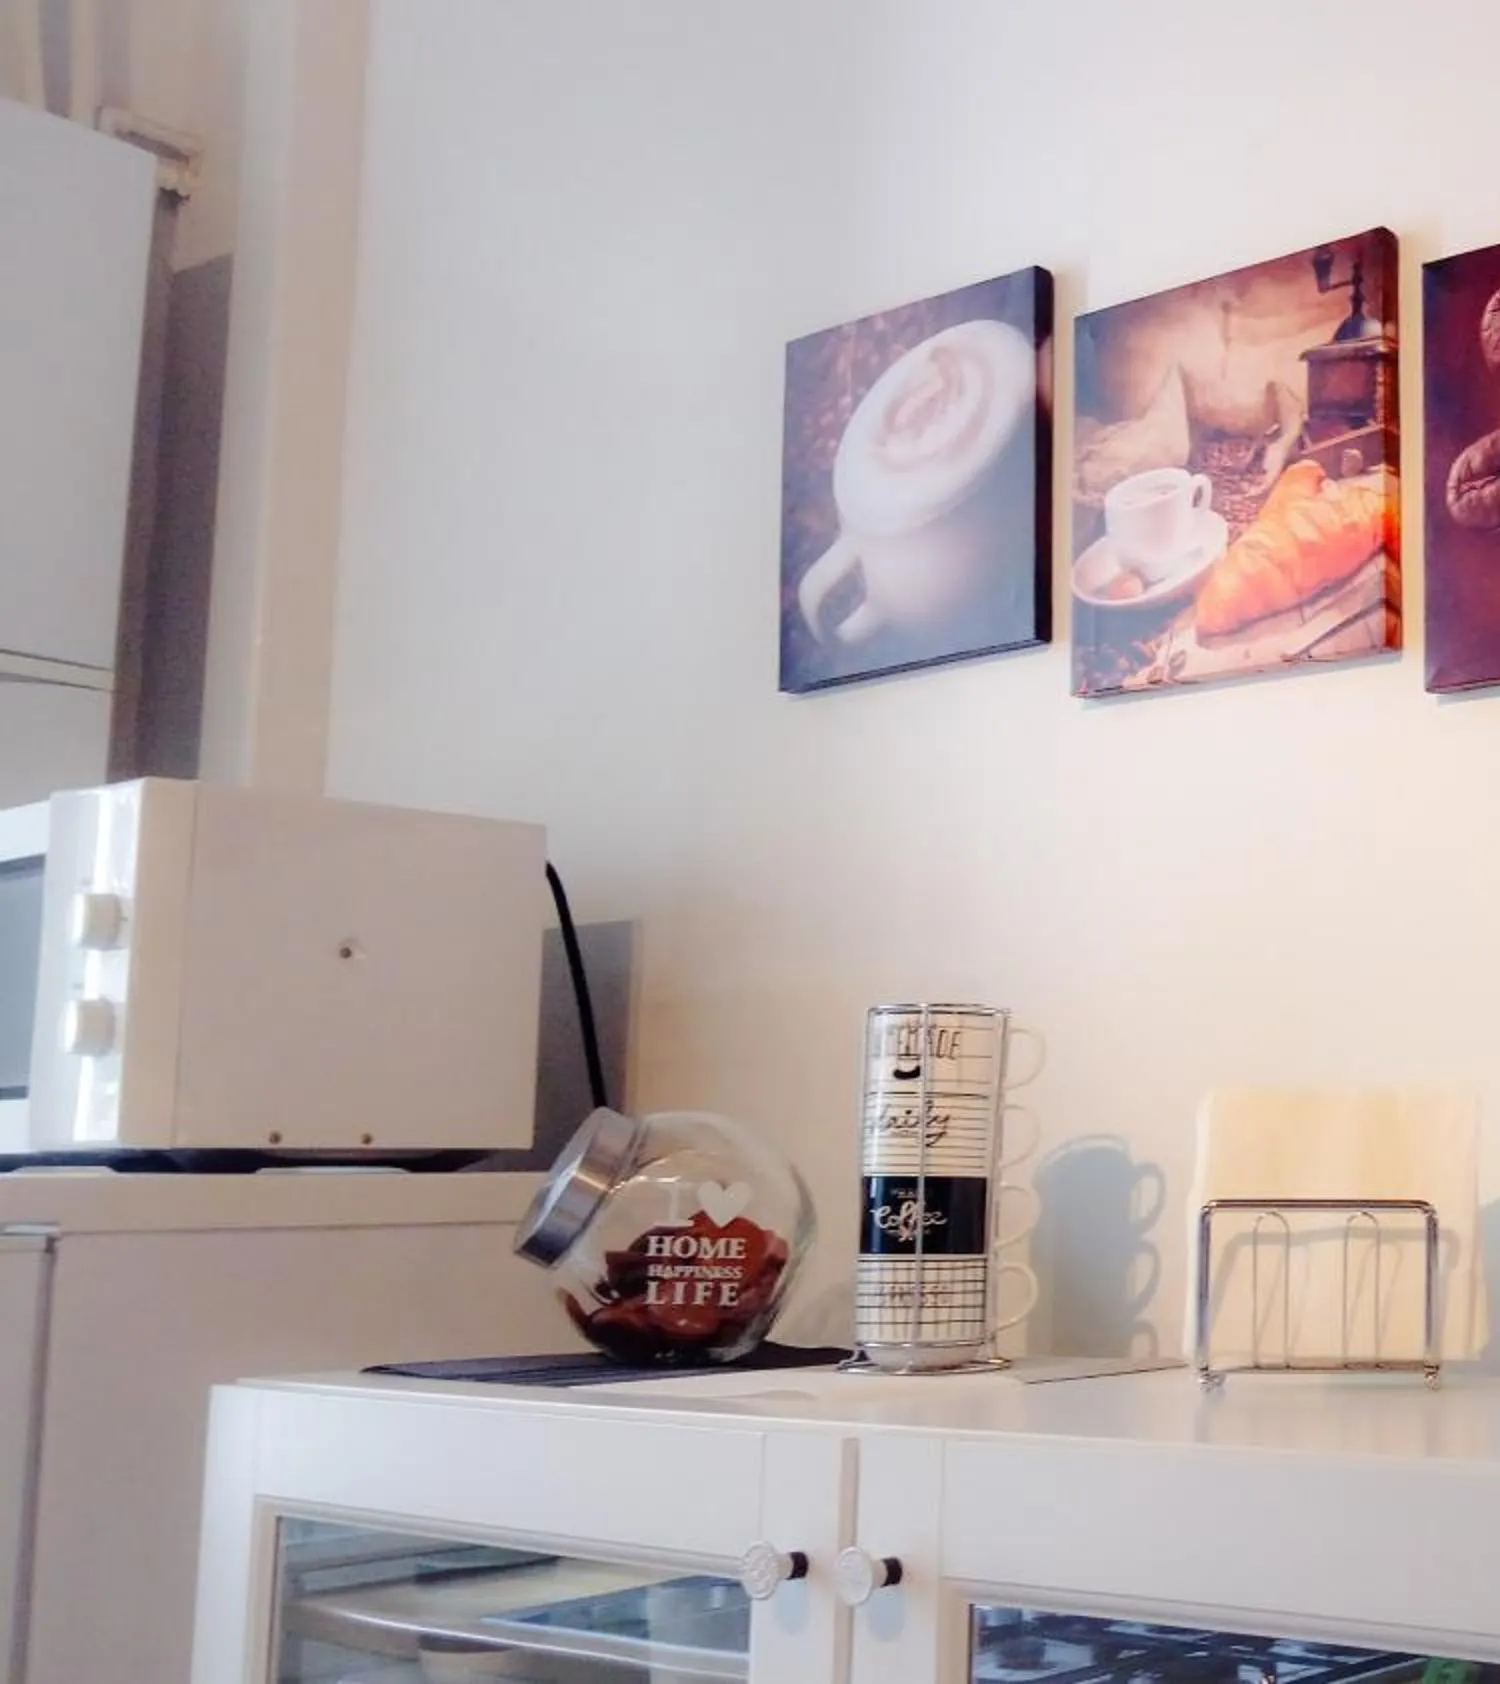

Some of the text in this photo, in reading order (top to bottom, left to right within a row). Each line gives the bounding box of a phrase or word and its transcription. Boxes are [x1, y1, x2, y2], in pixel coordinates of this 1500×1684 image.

[645, 1235, 746, 1260] HOME
[648, 1264, 744, 1280] HAPPINESS
[643, 1281, 742, 1307] LIFE
